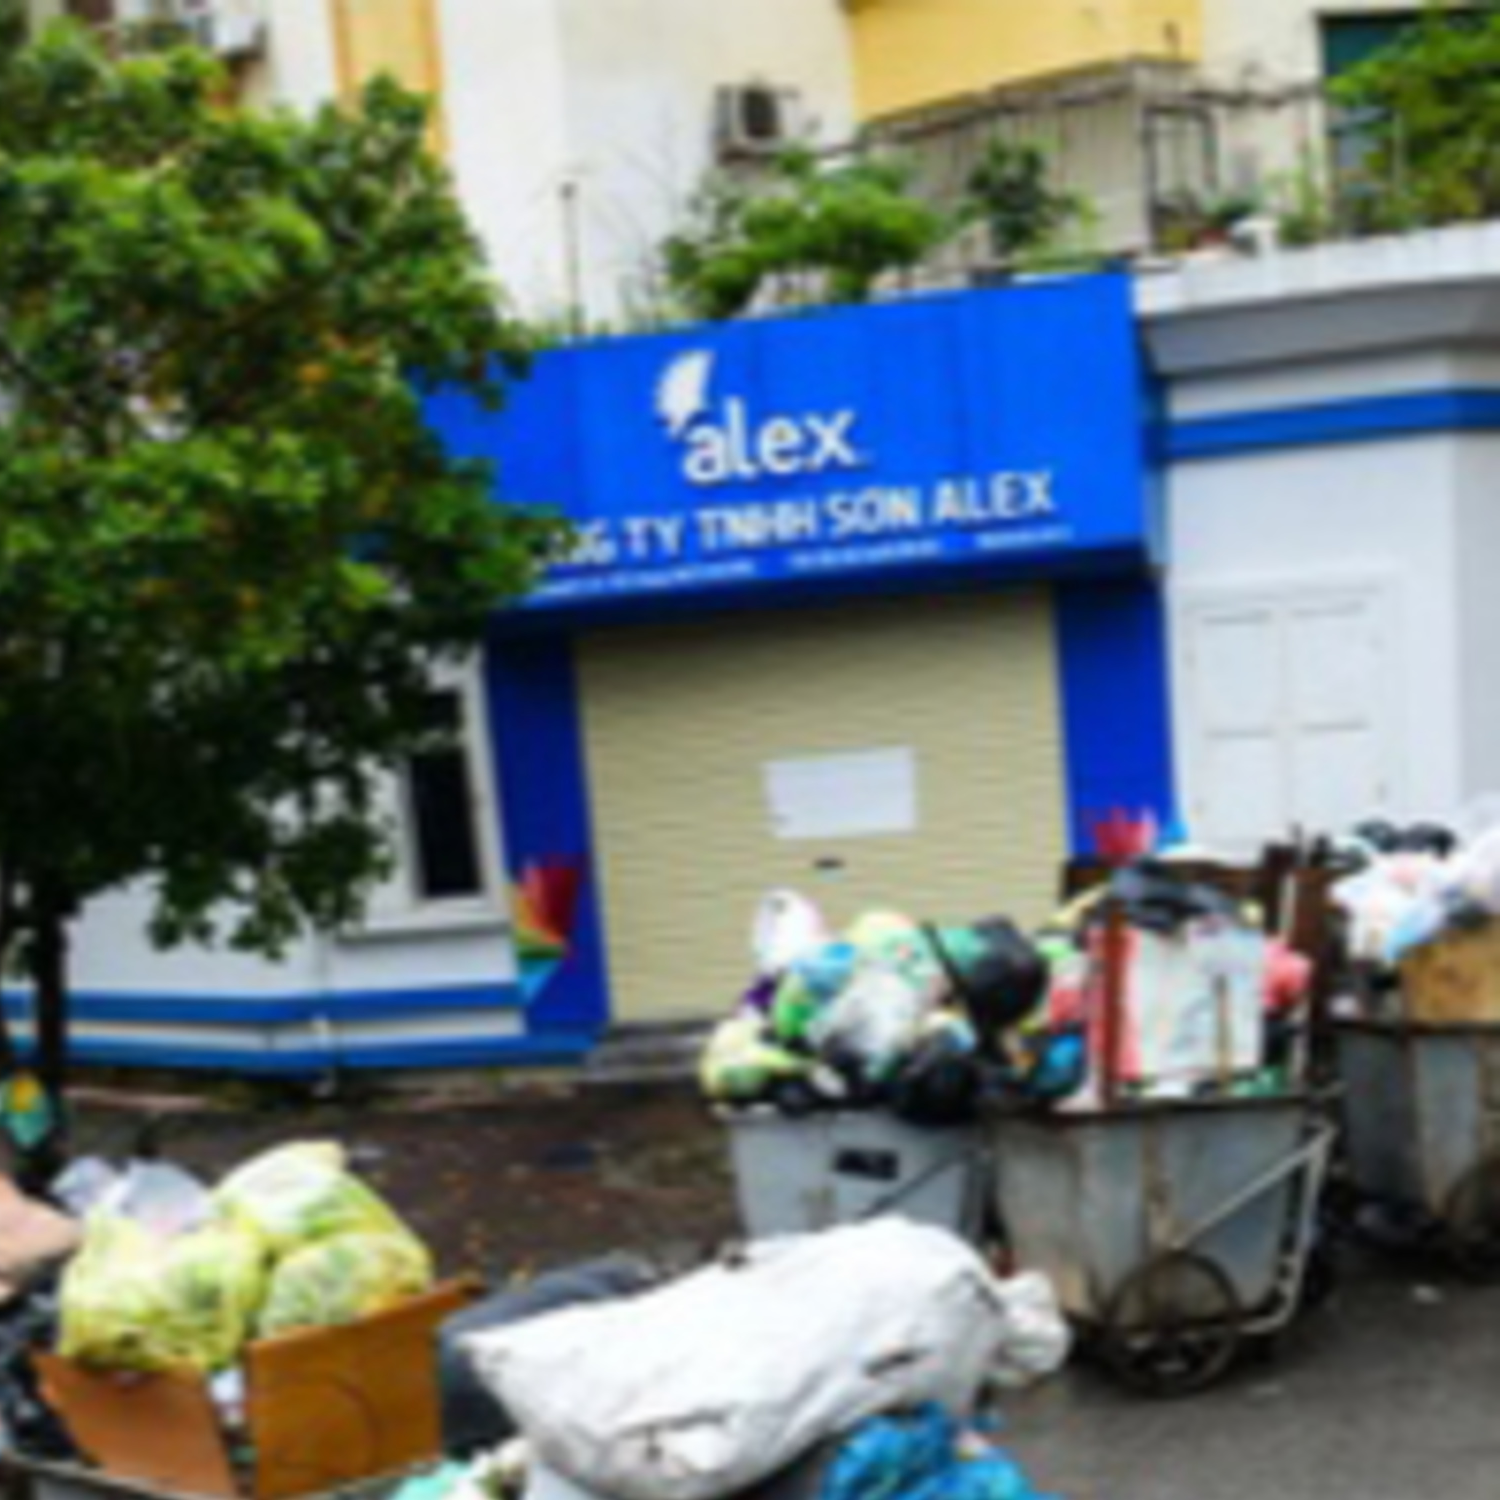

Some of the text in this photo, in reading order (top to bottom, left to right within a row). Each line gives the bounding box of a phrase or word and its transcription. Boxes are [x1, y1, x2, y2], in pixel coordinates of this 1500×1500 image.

[680, 397, 859, 484] alex
[621, 513, 684, 559] TY
[694, 496, 817, 551] TNHH
[933, 467, 1059, 529] ALEX
